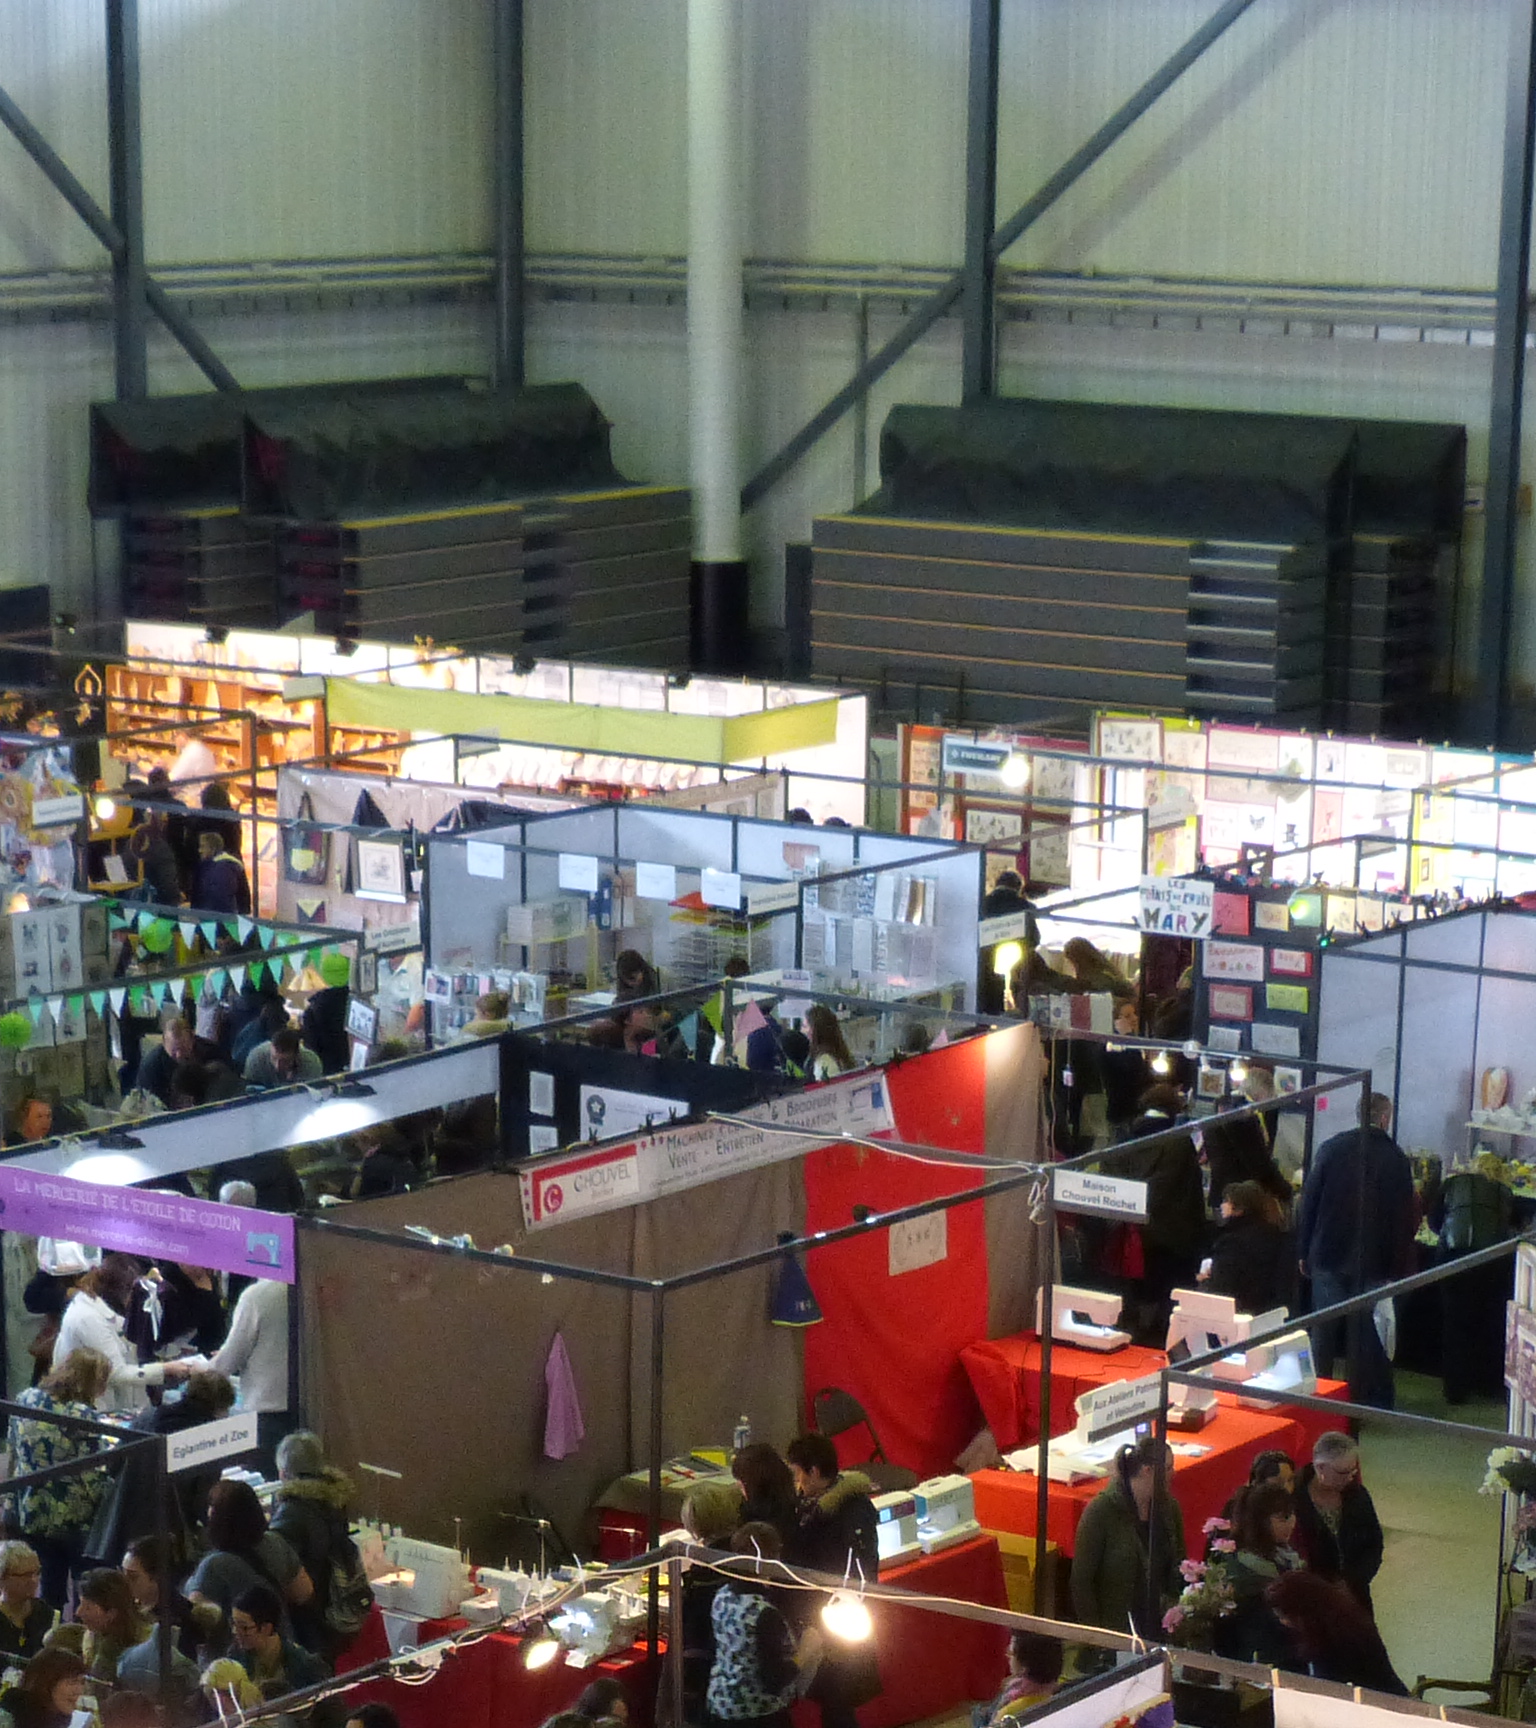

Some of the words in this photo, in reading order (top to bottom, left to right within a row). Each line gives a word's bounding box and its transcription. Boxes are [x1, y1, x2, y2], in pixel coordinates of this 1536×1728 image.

[1168, 879, 1186, 889] LES
[1144, 907, 1209, 933] MARY
[574, 1163, 631, 1192] CHOUVEL
[1082, 1179, 1117, 1194] Maison
[14, 1177, 31, 1194] LA
[34, 1182, 98, 1206] MERCERIE
[102, 1194, 120, 1210] DE
[179, 1207, 196, 1224] DE
[199, 1211, 242, 1232] COTON
[1061, 1189, 1101, 1205] Chouvel
[1102, 1195, 1137, 1212] Rochet
[173, 1440, 217, 1459] Eglantine
[219, 1434, 228, 1445] et
